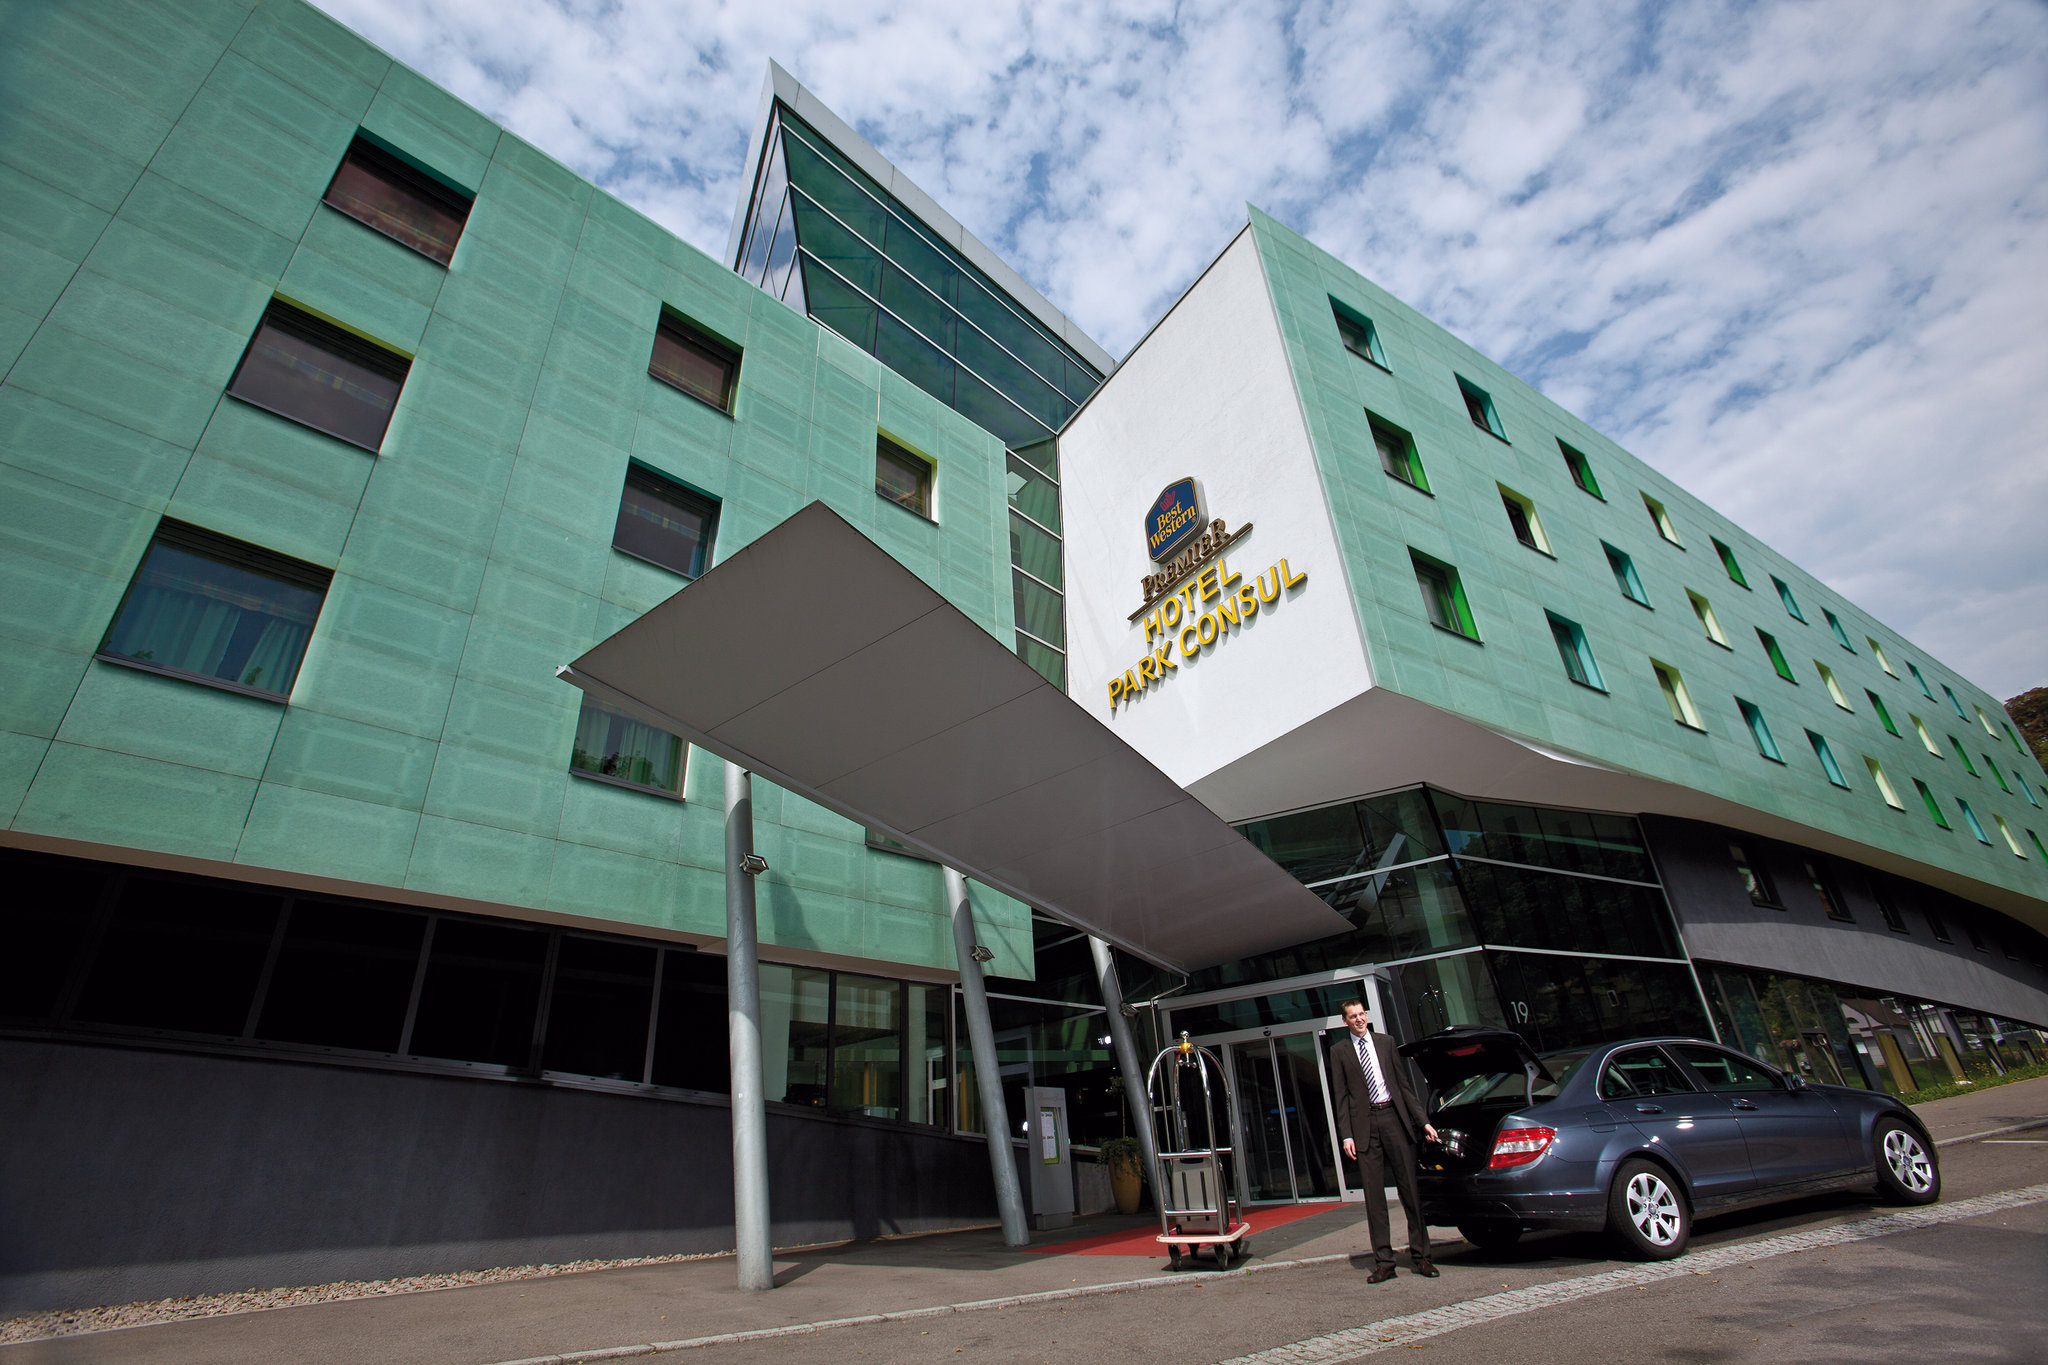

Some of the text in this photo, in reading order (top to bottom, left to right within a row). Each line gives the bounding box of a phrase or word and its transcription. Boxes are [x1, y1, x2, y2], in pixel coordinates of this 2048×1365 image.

[1150, 505, 1197, 549] Western
[1156, 500, 1183, 531] Best
[1140, 518, 1231, 602] PREMIER
[1143, 558, 1242, 644] HOTEL
[1108, 558, 1308, 710] PARK CONSUL
[1511, 1001, 1528, 1024] 19
